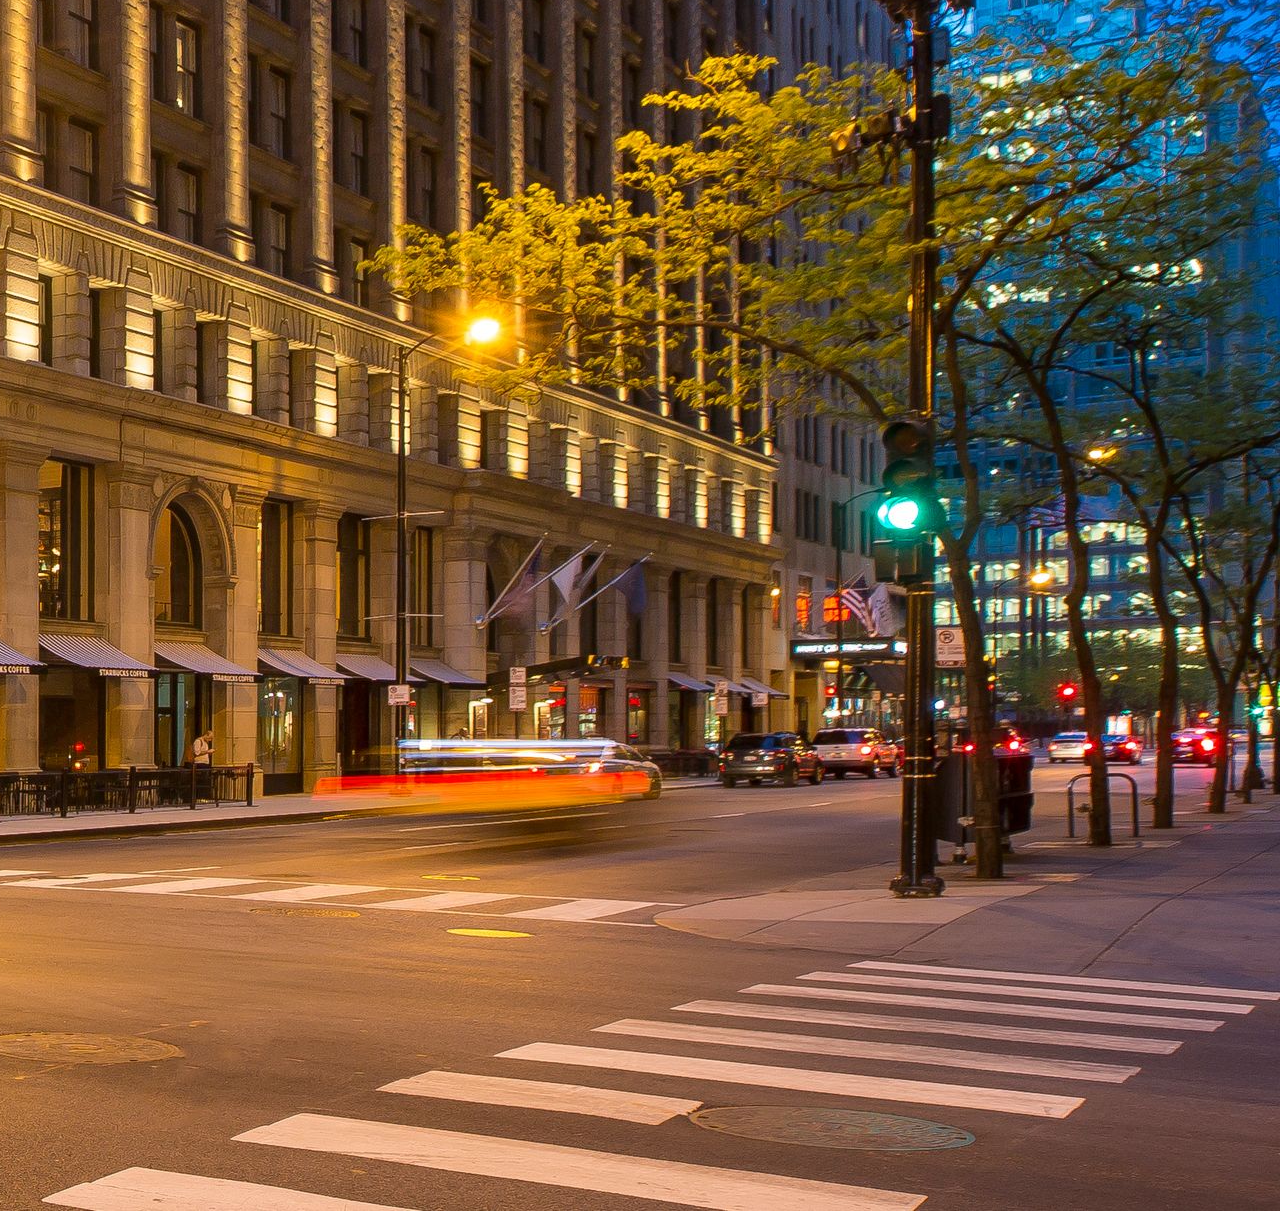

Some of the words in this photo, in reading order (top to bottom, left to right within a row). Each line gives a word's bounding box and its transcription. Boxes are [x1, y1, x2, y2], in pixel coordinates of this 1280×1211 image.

[7, 665, 30, 674] COFFEE
[99, 668, 130, 677] STARBUCKS
[130, 670, 148, 678] COFFEE
[212, 674, 238, 682] STARBUCKS
[238, 675, 254, 683] COFFEE
